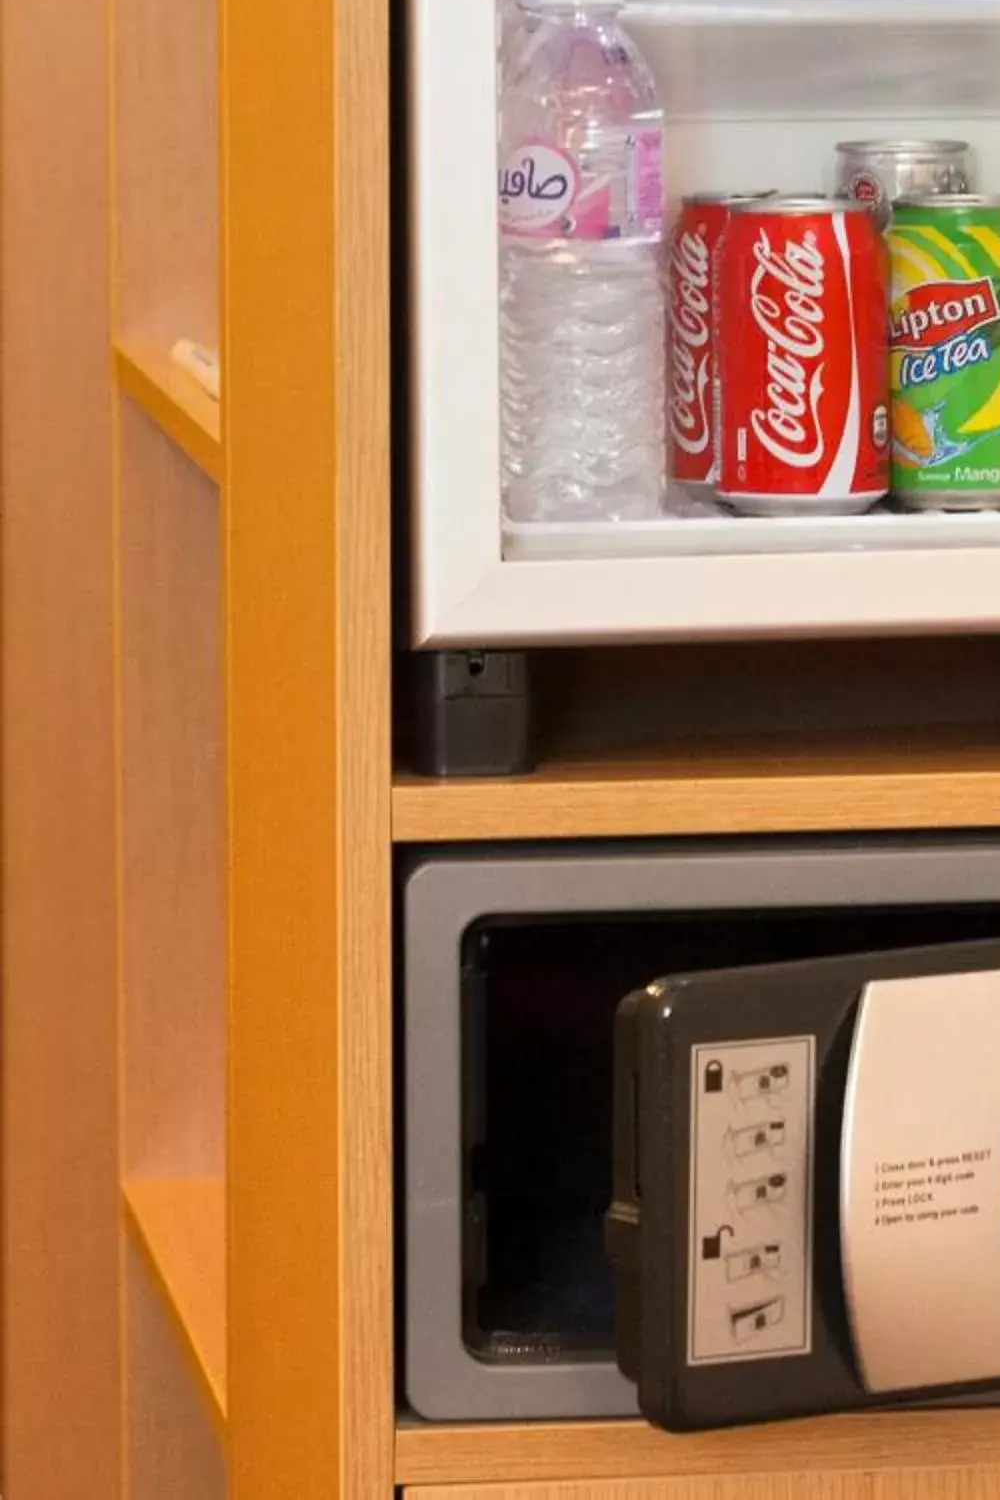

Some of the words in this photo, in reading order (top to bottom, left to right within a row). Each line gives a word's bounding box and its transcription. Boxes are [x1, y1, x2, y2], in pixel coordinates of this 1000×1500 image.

[751, 227, 826, 468] Coca-Cola
[902, 355, 938, 386] Ice
[941, 334, 990, 372] Tea
